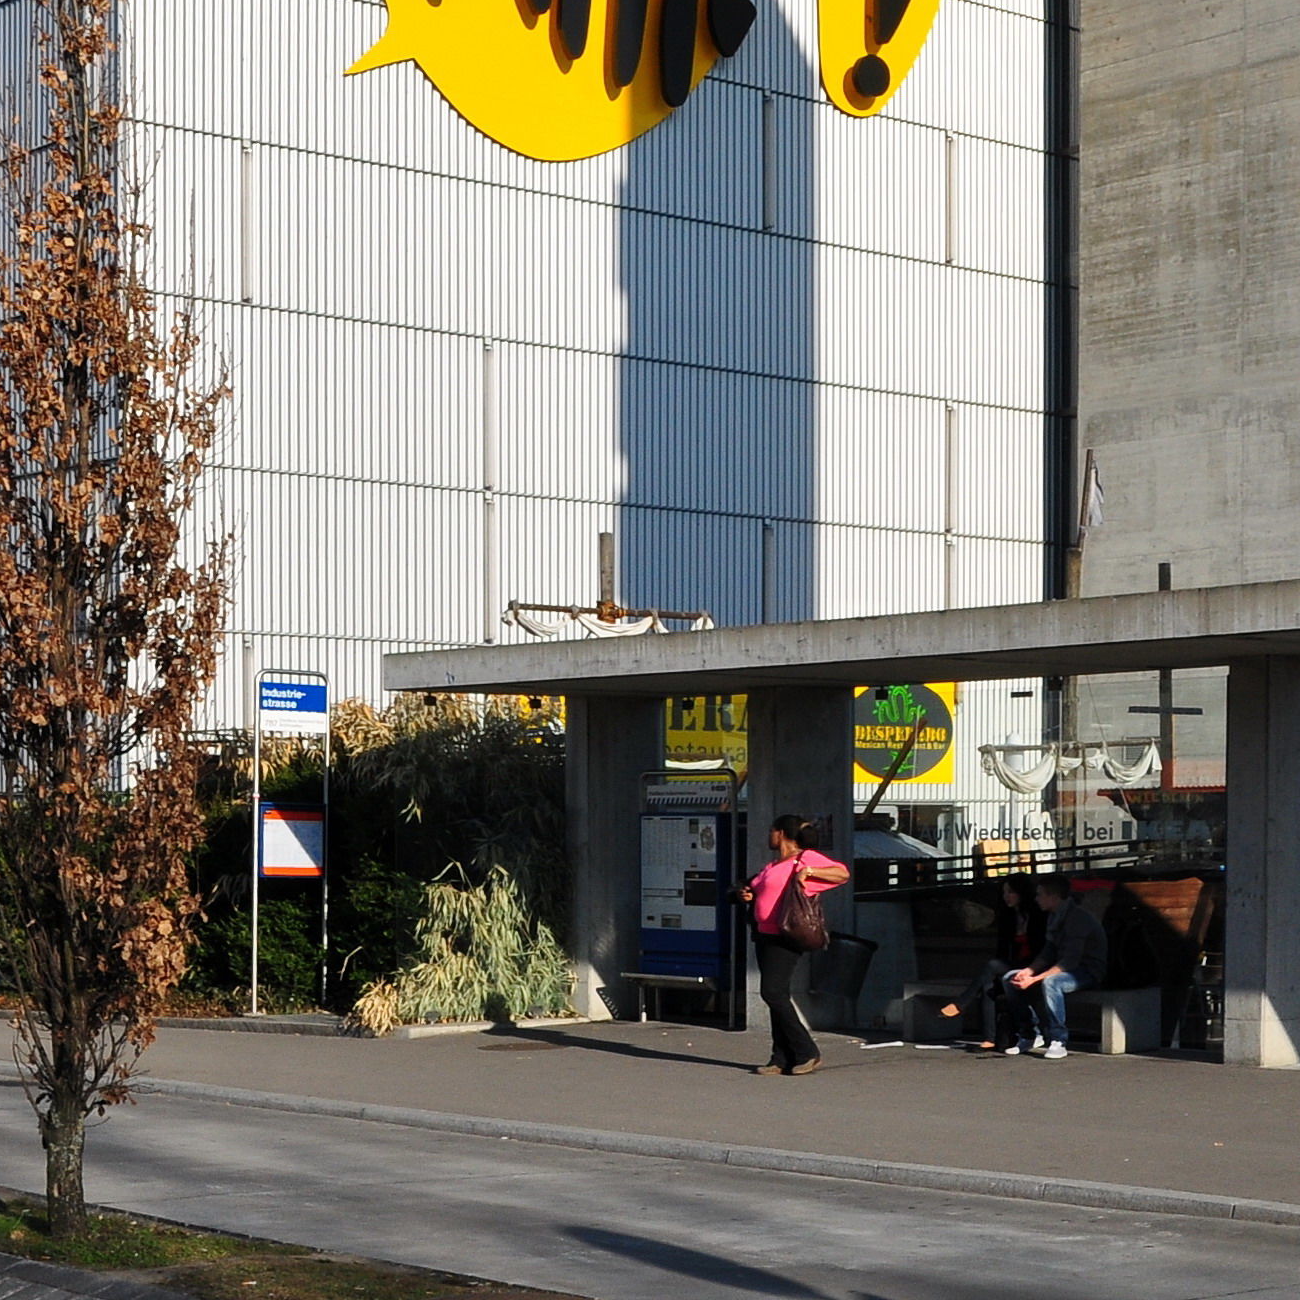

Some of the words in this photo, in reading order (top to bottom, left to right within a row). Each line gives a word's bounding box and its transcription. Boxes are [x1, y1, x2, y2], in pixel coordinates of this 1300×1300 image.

[262, 698, 298, 709] strasse
[920, 821, 950, 841] Auf
[1084, 821, 1114, 841] bei
